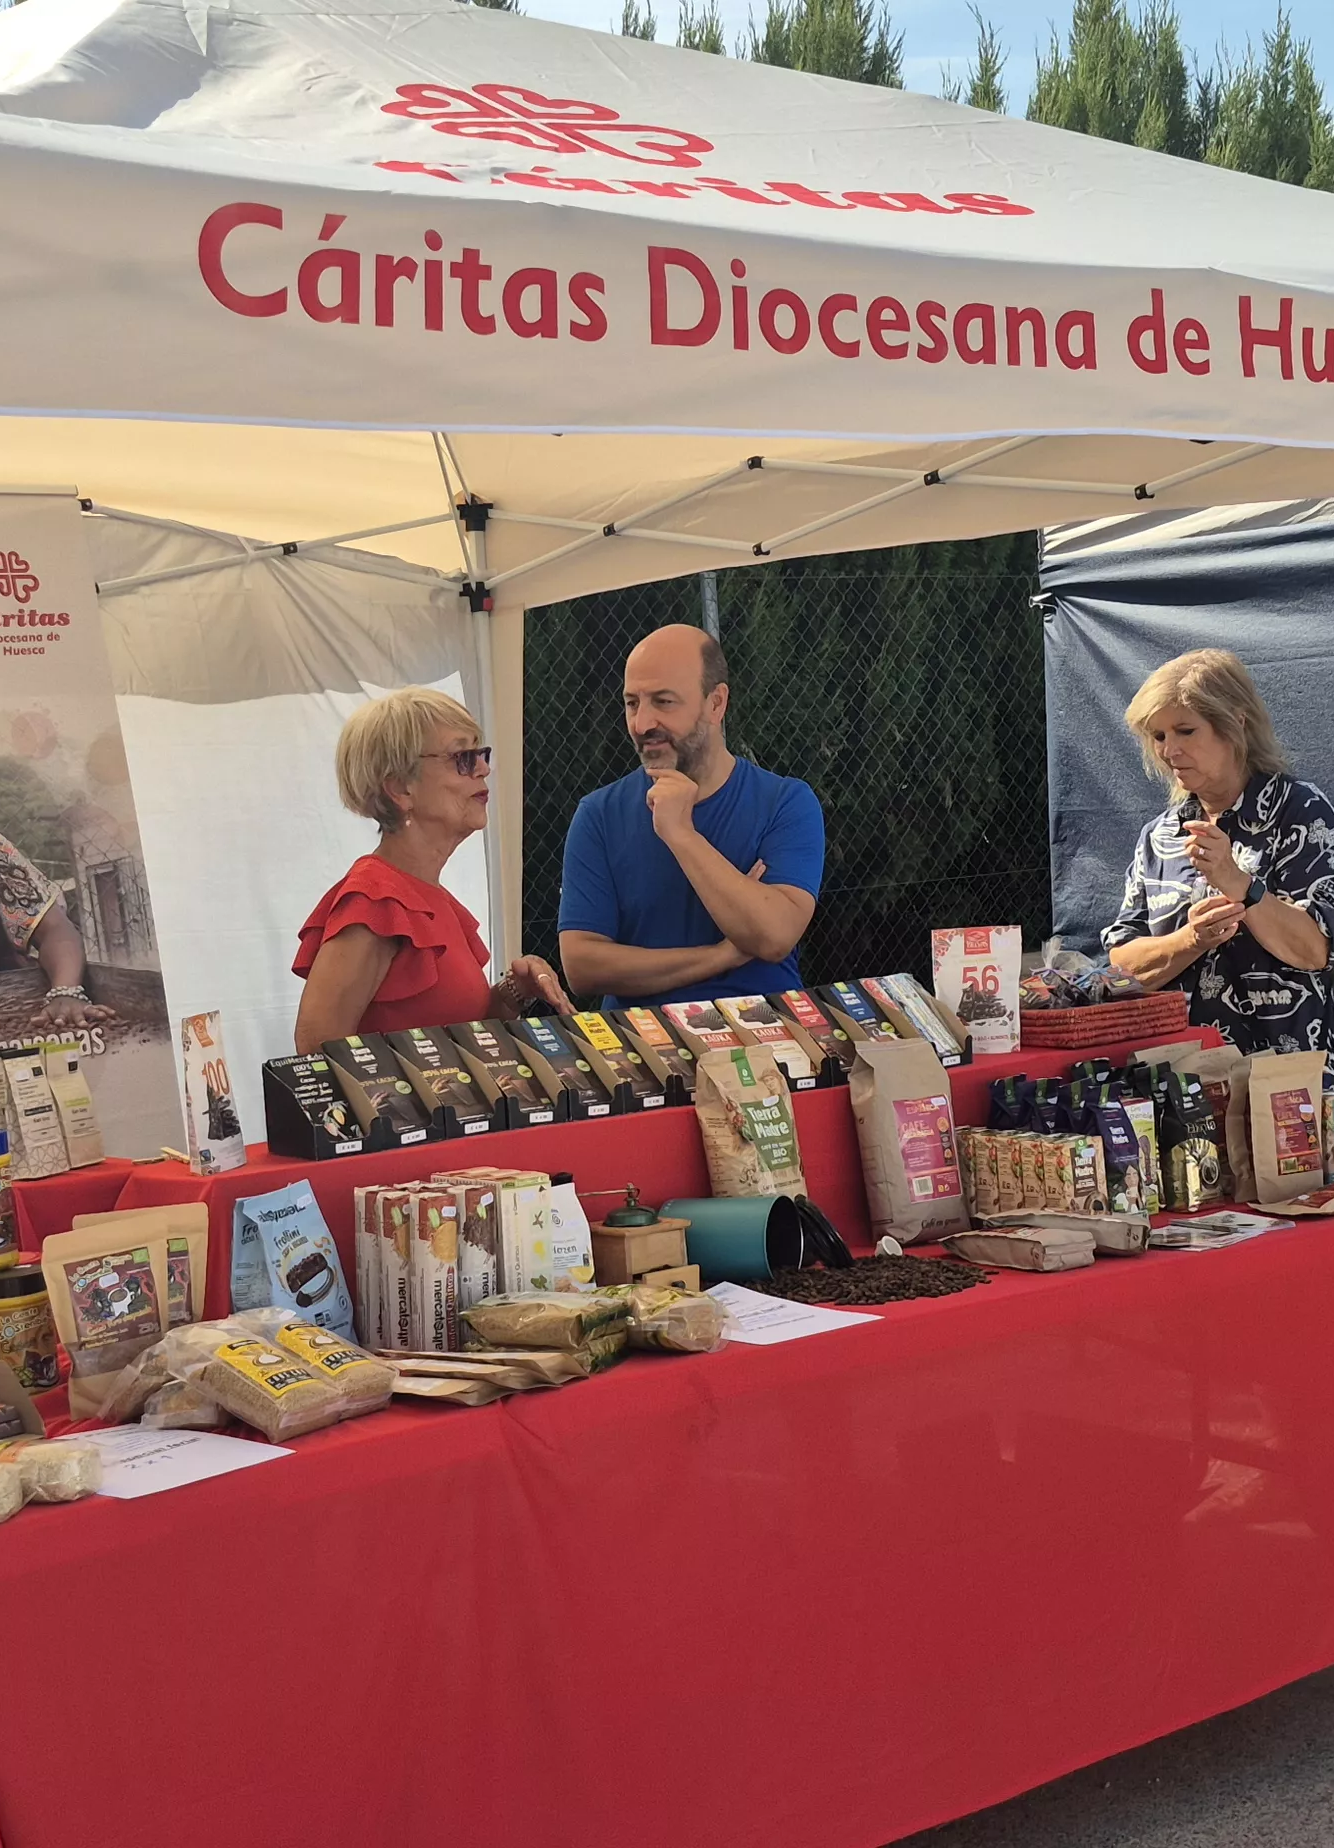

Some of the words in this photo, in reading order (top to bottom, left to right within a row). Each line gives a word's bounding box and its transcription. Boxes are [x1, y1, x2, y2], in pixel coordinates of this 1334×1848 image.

[198, 202, 607, 342] Cáritas
[647, 245, 1097, 371] Diocesana
[1127, 288, 1211, 376] de
[47, 631, 61, 642] de
[3, 646, 45, 656] Huesca
[700, 1033, 732, 1043] KAOKA
[751, 1027, 783, 1038] KAOKA
[747, 1106, 781, 1121] Tierra
[754, 1121, 789, 1138] Madre
[772, 1148, 787, 1158] BIO
[274, 1225, 301, 1250] frollini
